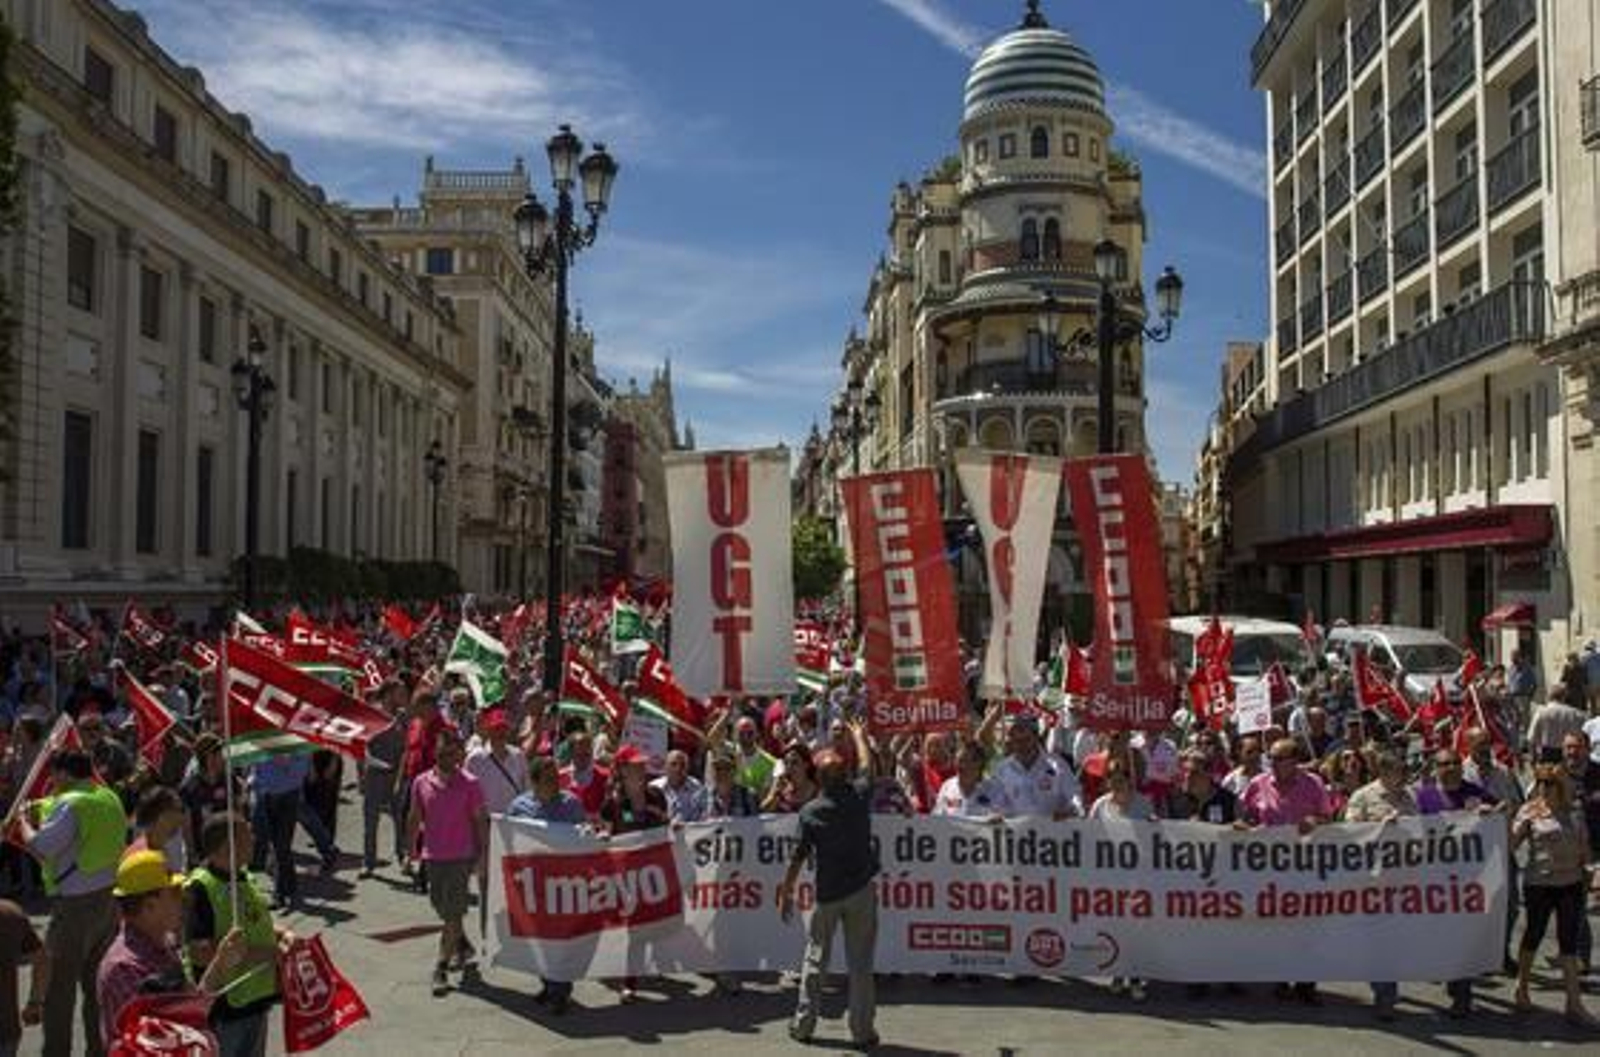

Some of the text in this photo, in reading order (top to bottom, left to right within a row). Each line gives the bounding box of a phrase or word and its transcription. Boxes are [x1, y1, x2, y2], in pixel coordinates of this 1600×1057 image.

[704, 456, 753, 692] UGT
[871, 481, 924, 648] CCOO
[1091, 466, 1134, 642] CCOO
[228, 666, 365, 738] CCOO
[874, 700, 957, 725] Sevilla
[695, 828, 743, 867] sin
[897, 828, 937, 863] de
[950, 828, 1080, 868] calidad
[1095, 839, 1139, 869] no
[1152, 832, 1217, 878] hay
[1230, 824, 1483, 880] recuperación
[514, 864, 668, 917] 1 mayo
[690, 871, 763, 910] más
[947, 876, 1057, 914] social
[1071, 886, 1152, 922] para
[1166, 880, 1243, 919] más
[1257, 875, 1486, 918] democracia
